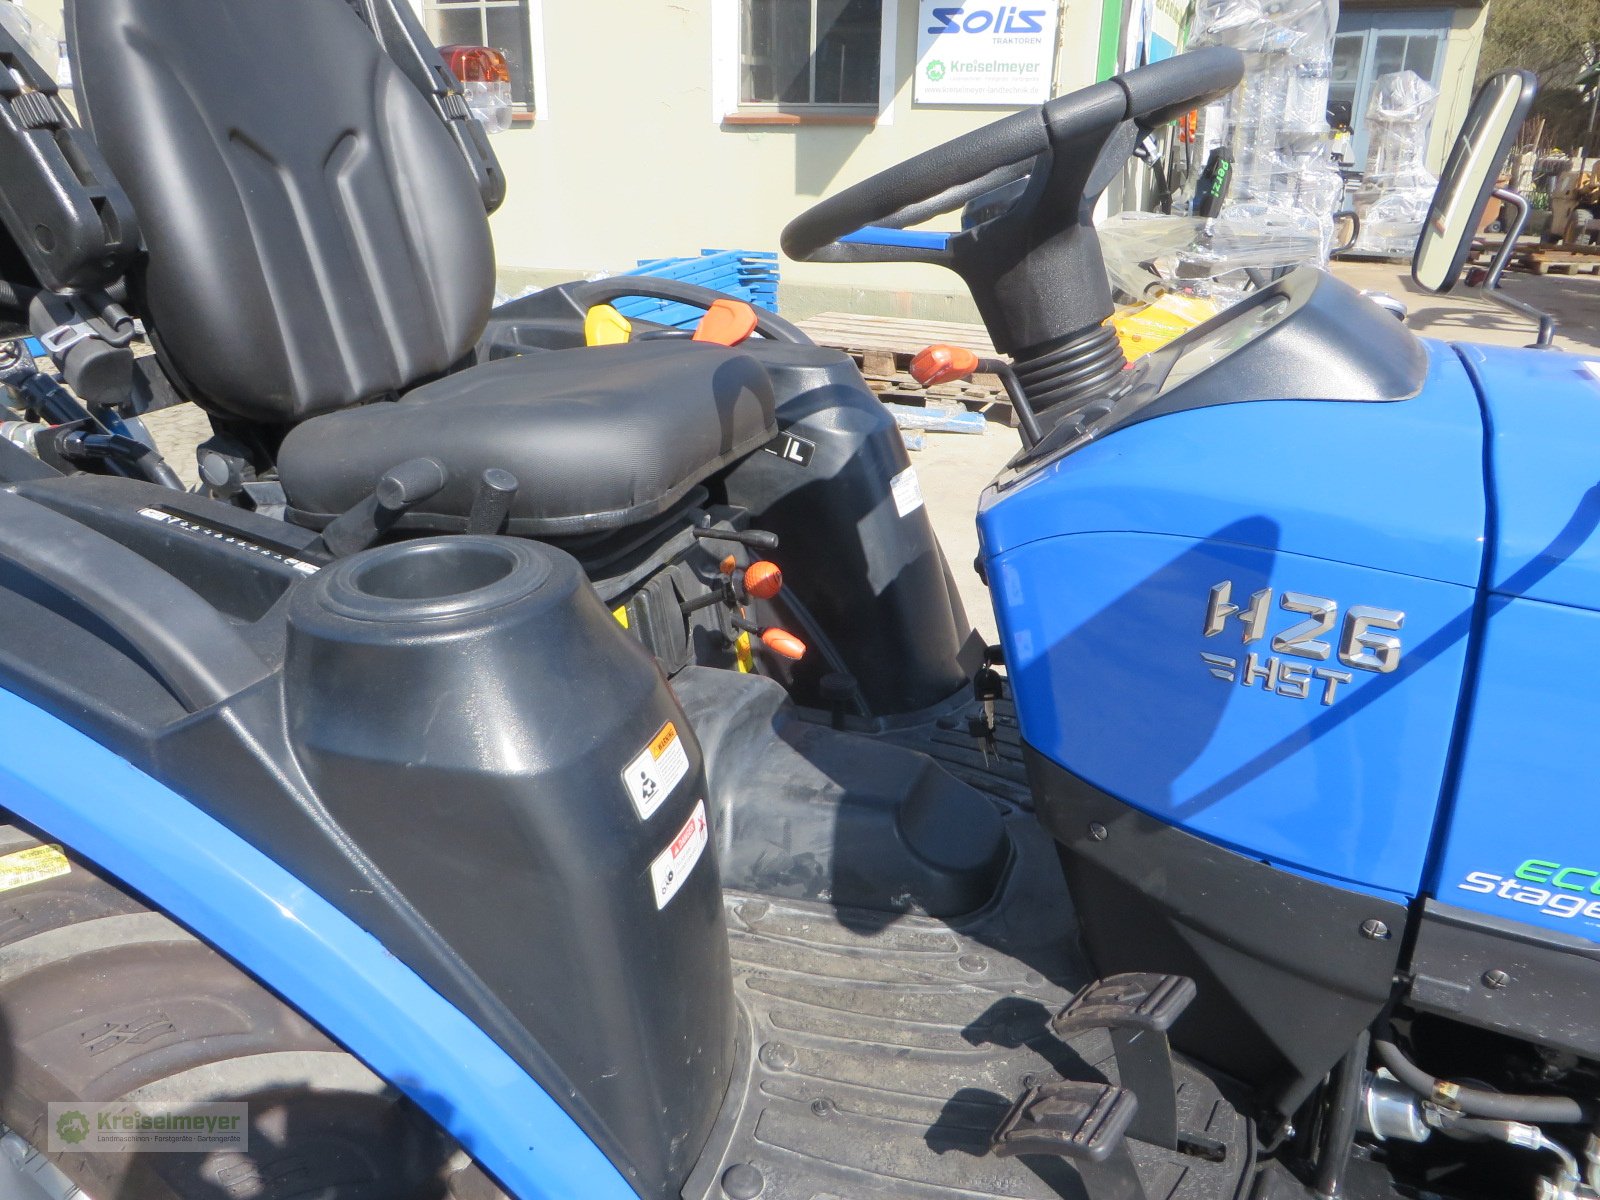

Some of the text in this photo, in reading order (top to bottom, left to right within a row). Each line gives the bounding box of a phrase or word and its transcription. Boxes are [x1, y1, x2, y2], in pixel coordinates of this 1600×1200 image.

[992, 37, 1042, 45] TRAKTOREN
[950, 59, 1040, 75] Kreiselmeyer
[924, 86, 1039, 95] www.kreiselmeyer-landtechnik.de
[1203, 579, 1405, 674] H26
[1239, 651, 1353, 707] HST
